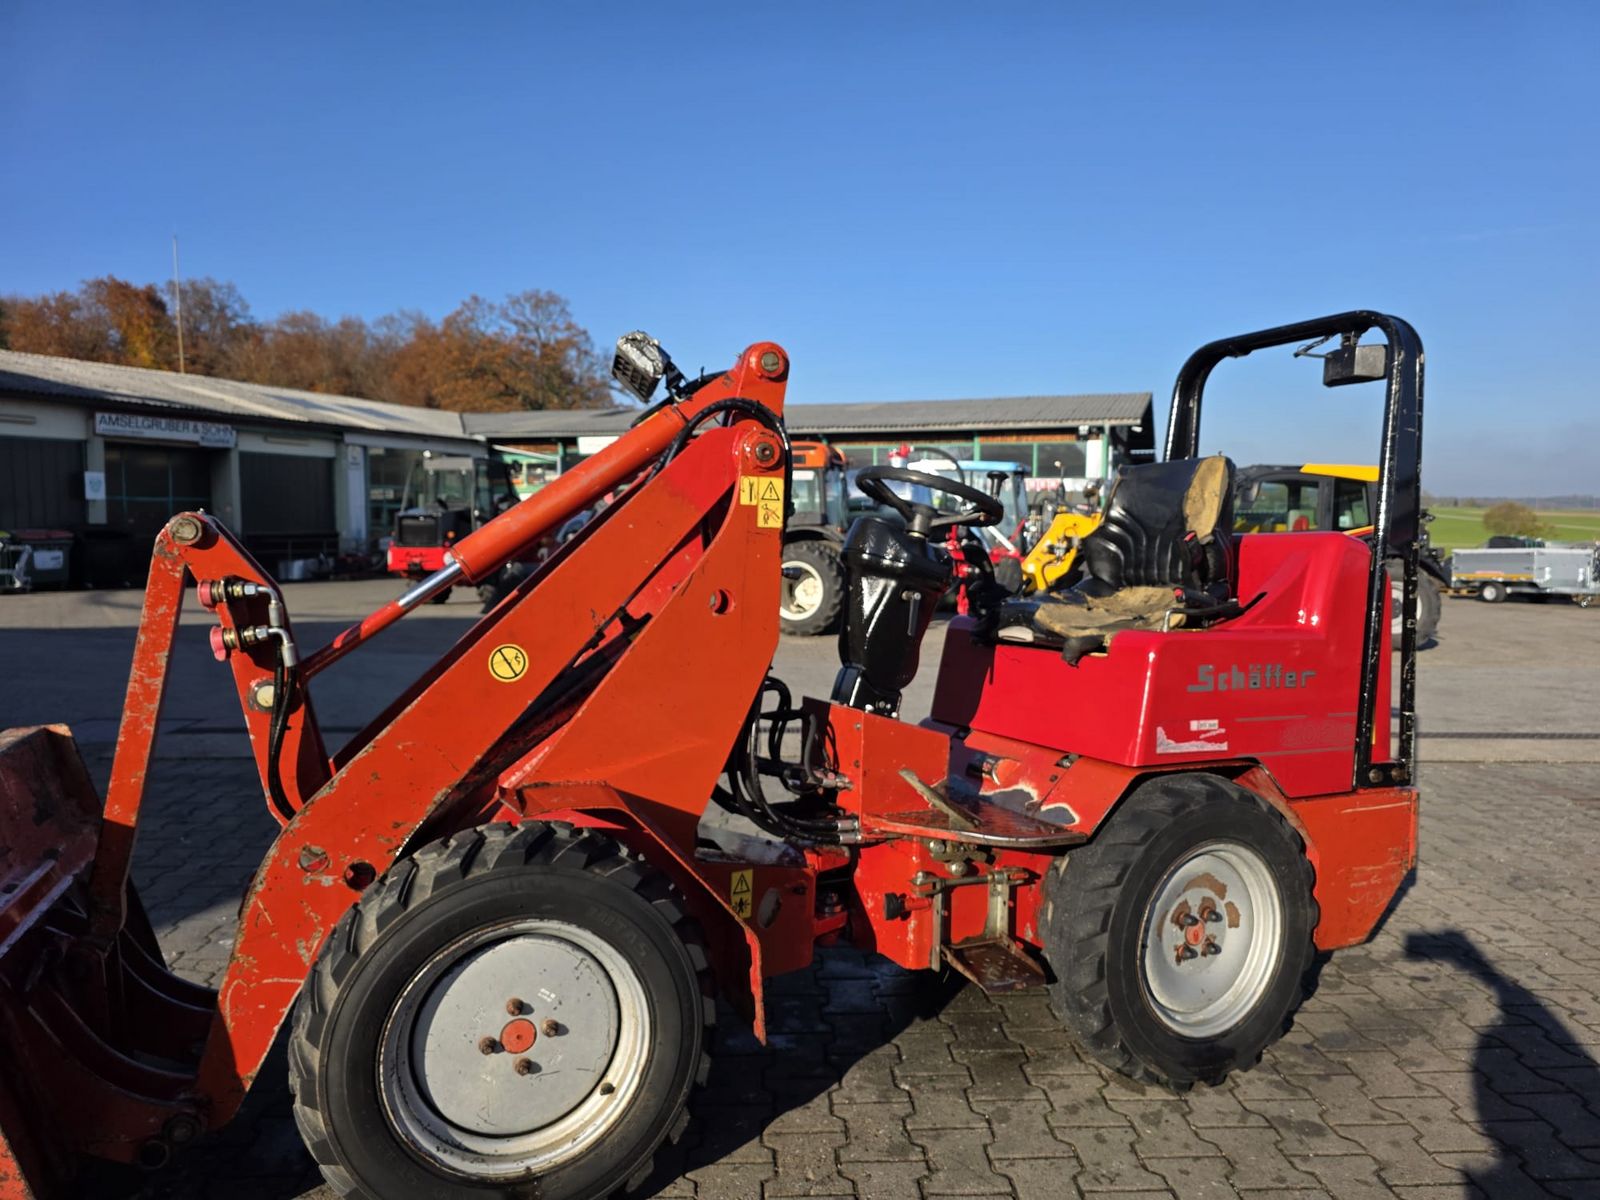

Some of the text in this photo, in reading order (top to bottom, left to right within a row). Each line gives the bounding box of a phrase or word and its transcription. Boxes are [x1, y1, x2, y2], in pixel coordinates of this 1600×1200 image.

[99, 414, 190, 433] AMSELGRUBER
[192, 423, 199, 434] &
[1187, 664, 1316, 692] Schäffer
[588, 904, 649, 958] MITAS
